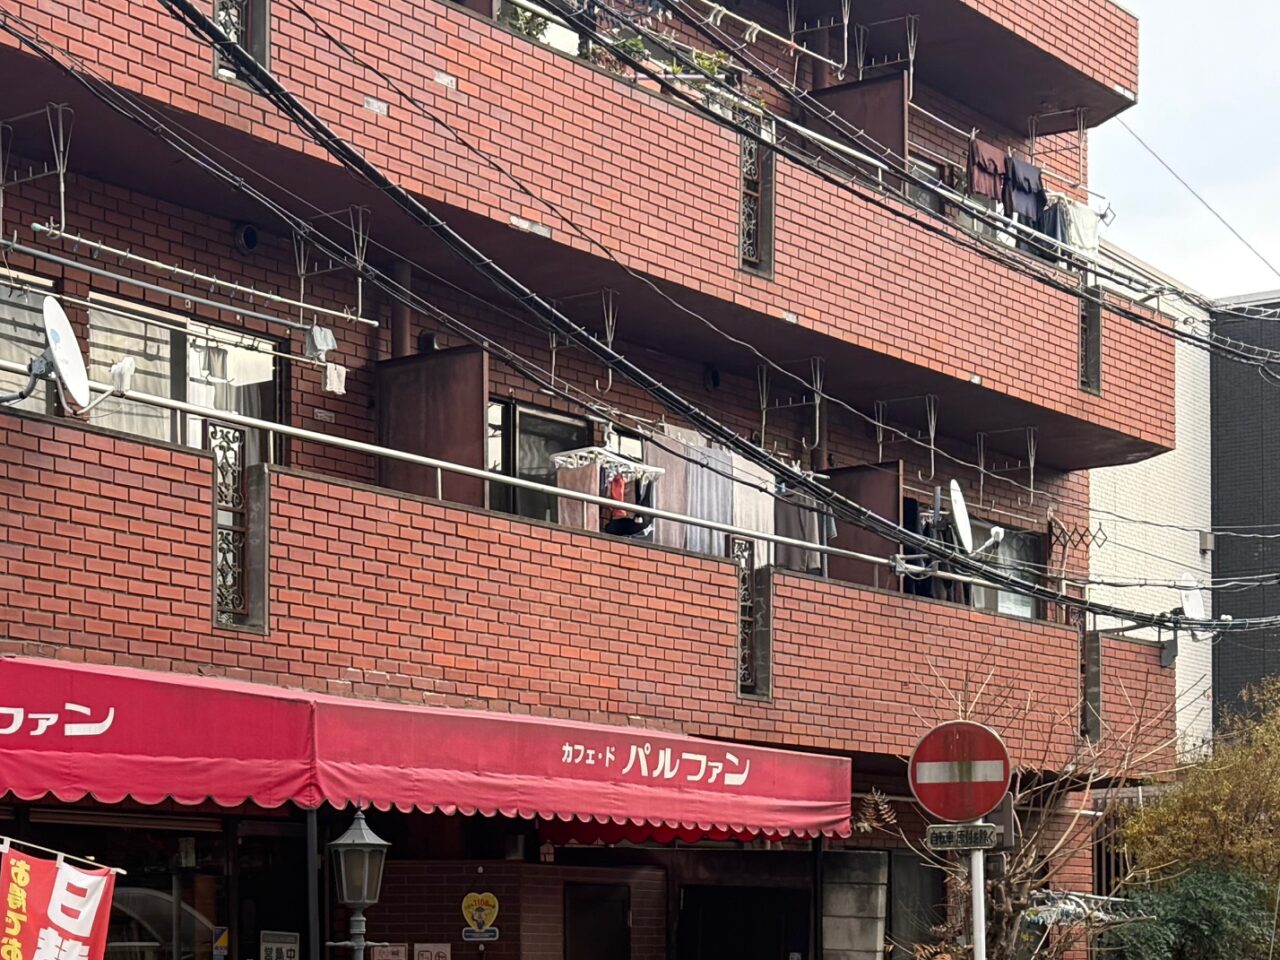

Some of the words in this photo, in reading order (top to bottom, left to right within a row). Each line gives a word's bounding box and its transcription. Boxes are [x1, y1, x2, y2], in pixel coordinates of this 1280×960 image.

[562, 742, 616, 767] カフェ・ド
[622, 743, 750, 785] パルファン
